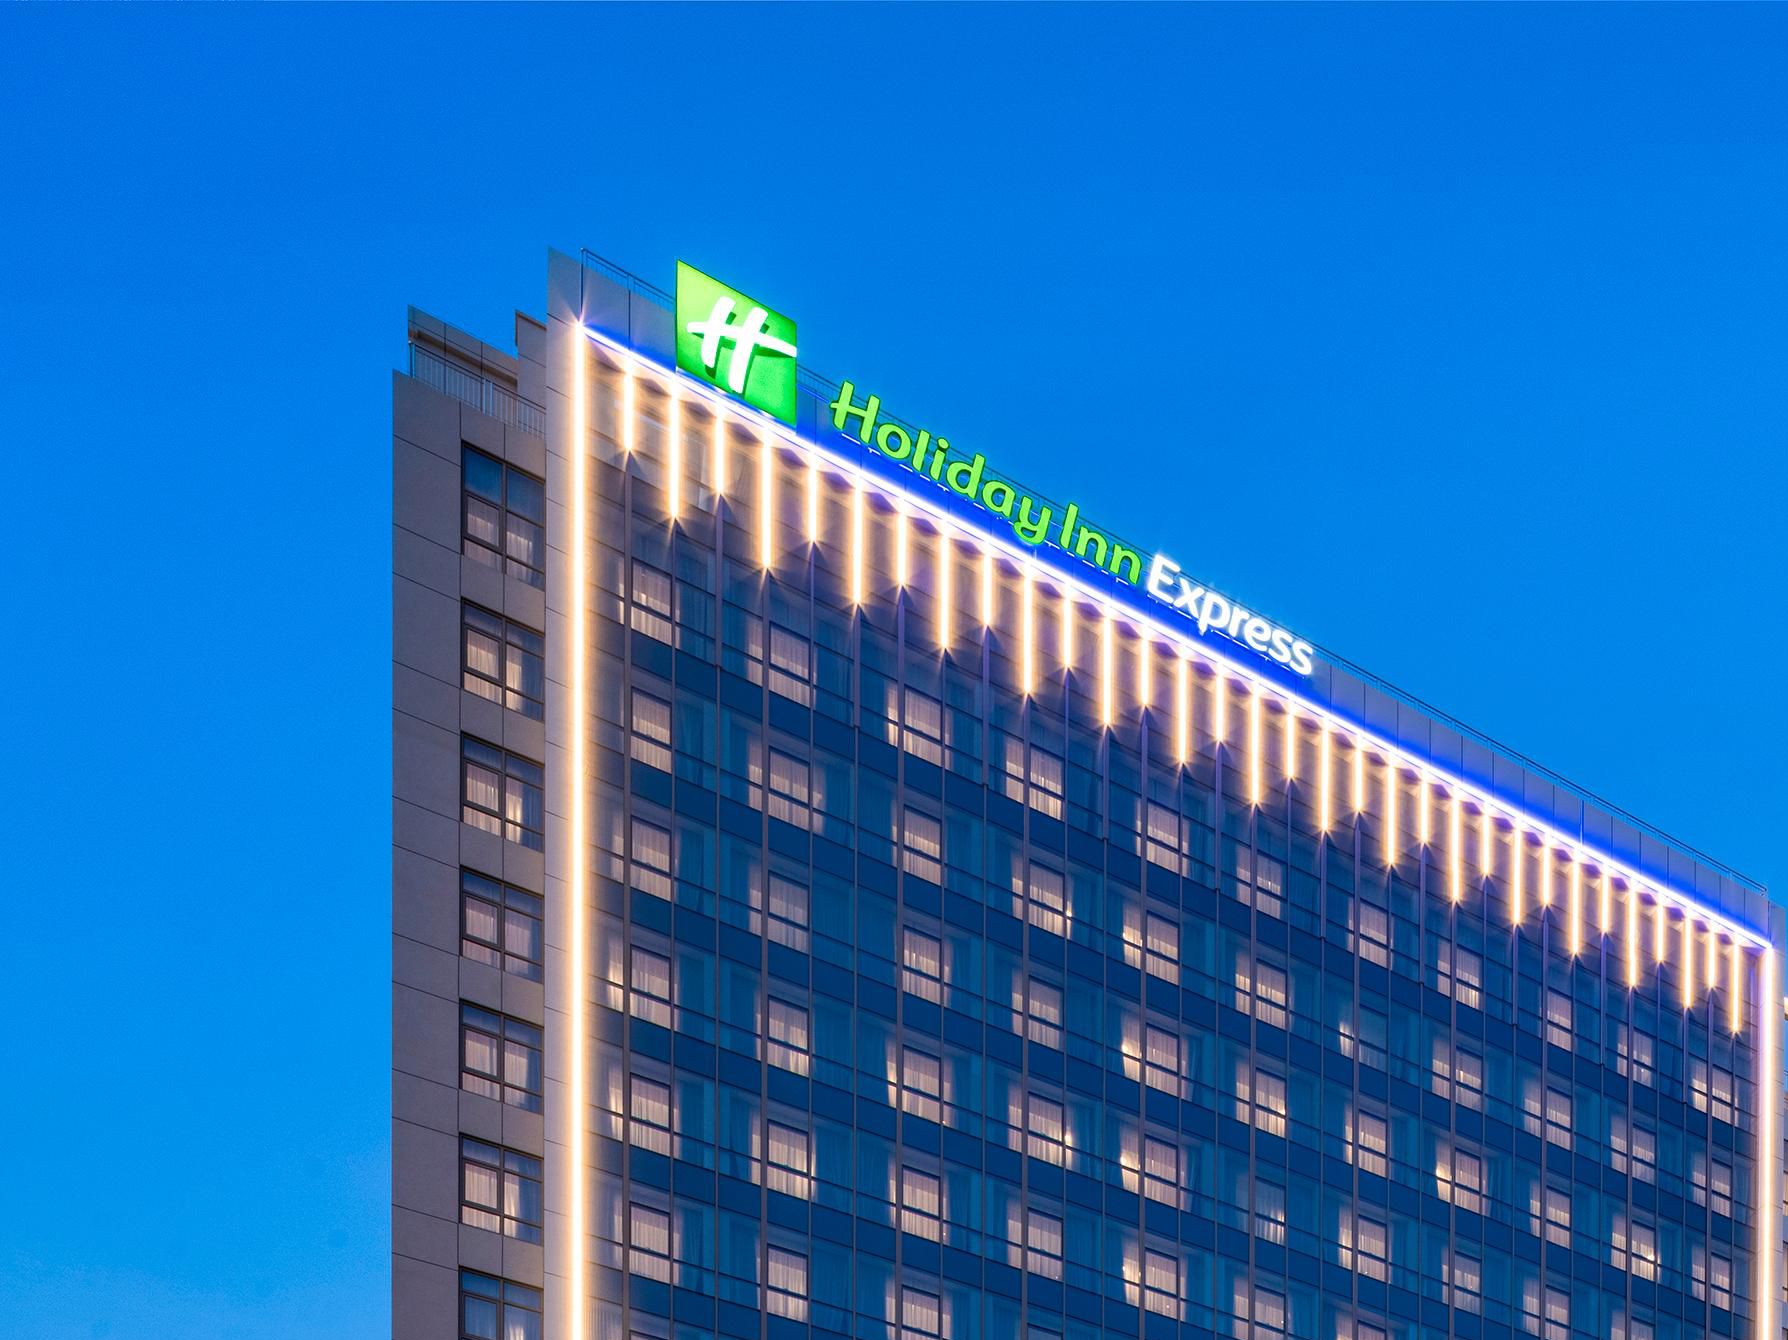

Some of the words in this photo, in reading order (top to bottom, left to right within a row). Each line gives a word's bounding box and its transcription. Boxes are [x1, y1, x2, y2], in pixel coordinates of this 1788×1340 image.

[829, 380, 1053, 544] Holiday
[1059, 503, 1142, 585] Inn
[1147, 555, 1313, 677] Express
